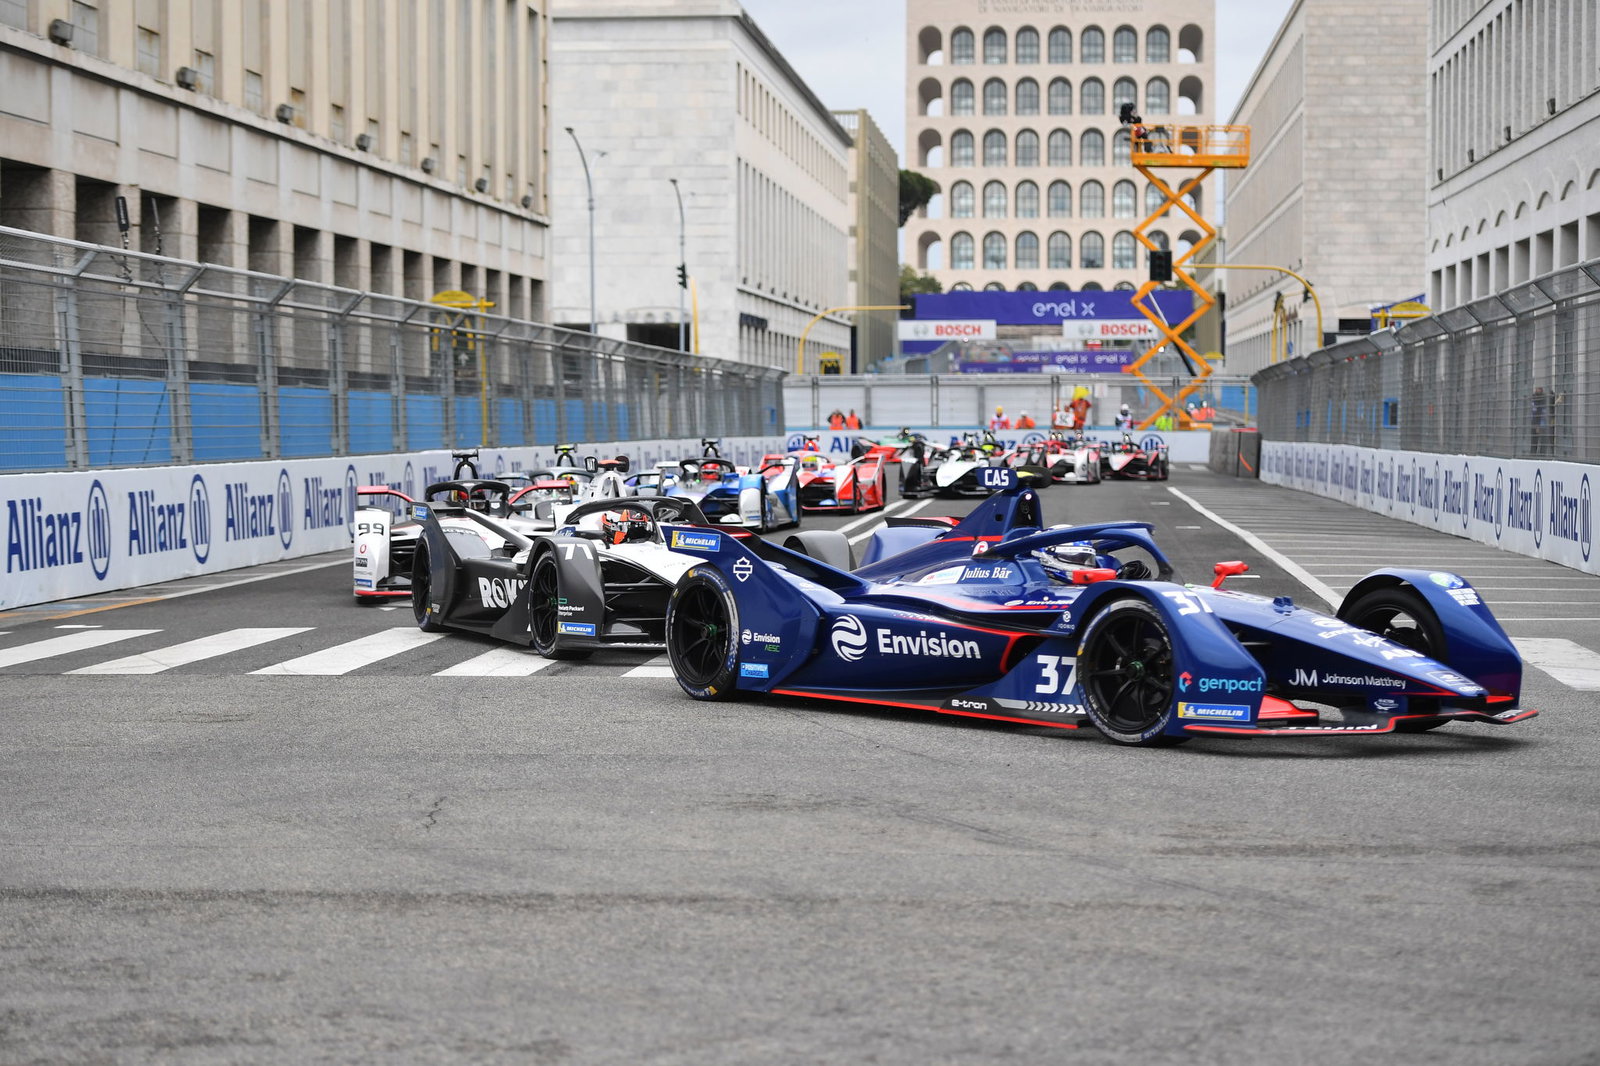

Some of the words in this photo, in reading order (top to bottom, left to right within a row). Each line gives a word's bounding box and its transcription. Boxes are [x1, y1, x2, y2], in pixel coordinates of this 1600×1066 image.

[1032, 299, 1076, 318] enel
[934, 324, 981, 336] BOSCH
[1101, 324, 1147, 336] BOSCH
[984, 469, 1009, 486] CAS
[1443, 470, 1462, 515] Allianz
[1473, 473, 1495, 524] Allianz
[225, 482, 276, 542] Allianz
[303, 477, 344, 530] Allianz
[1507, 477, 1533, 531] Allianz
[1549, 480, 1579, 542] Allianz
[128, 489, 187, 557] Allianz
[358, 523, 384, 536] 99
[7, 497, 83, 574] Allianz
[685, 537, 716, 546] MICHELIN
[961, 567, 991, 581] Julius
[991, 567, 1013, 579] Bär
[1161, 591, 1214, 616] 37
[753, 632, 781, 644] Envision
[876, 628, 982, 659] Envision
[1035, 654, 1078, 695] 37
[1198, 676, 1263, 694] genpact
[1289, 669, 1318, 687] JM
[1322, 672, 1364, 686] Johnson
[1365, 675, 1406, 690] Matthey
[951, 699, 987, 710] e-tron
[1196, 708, 1244, 717] MICHELIN
